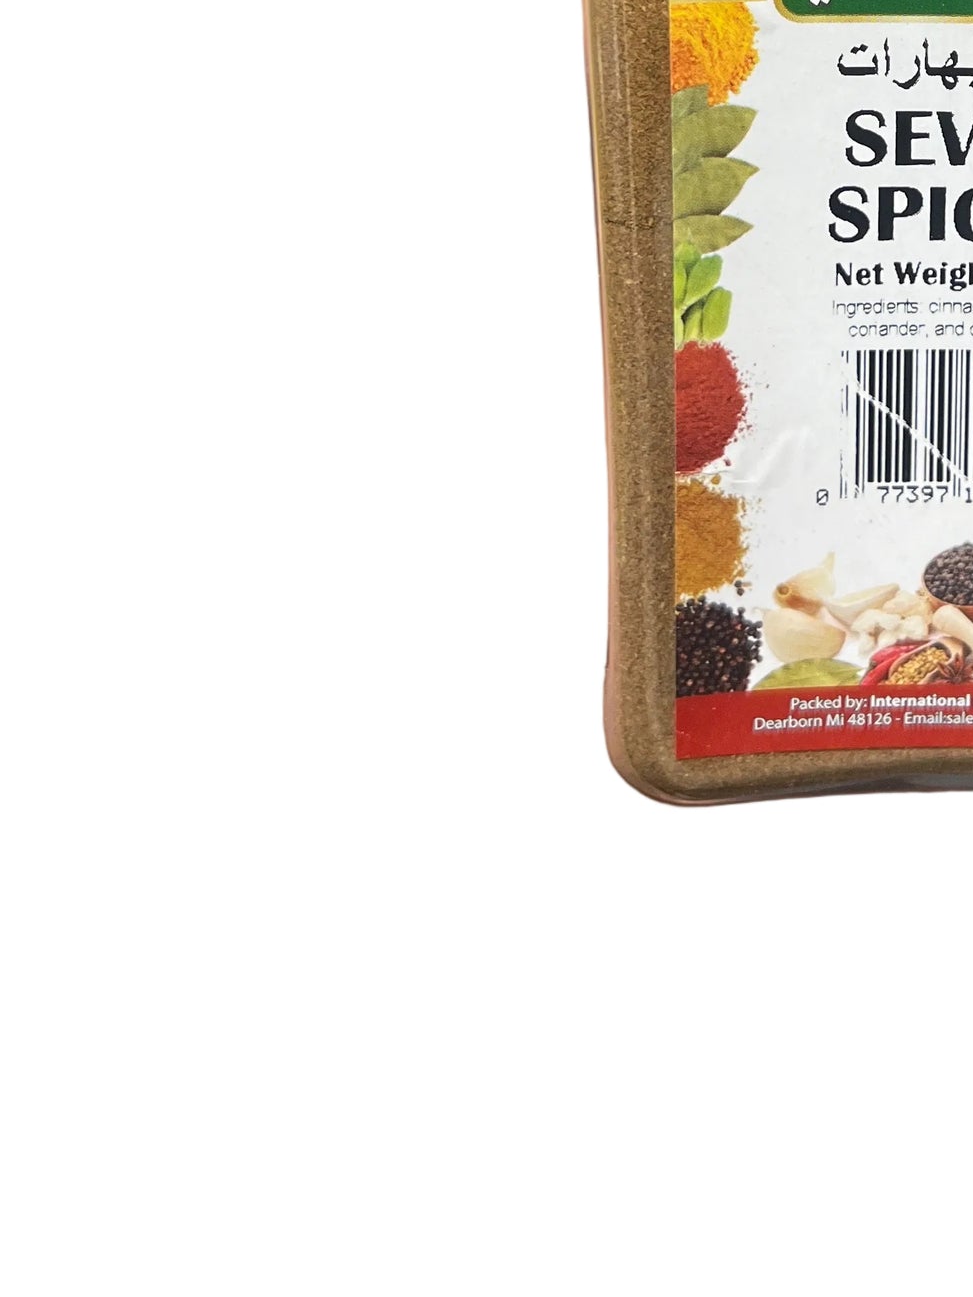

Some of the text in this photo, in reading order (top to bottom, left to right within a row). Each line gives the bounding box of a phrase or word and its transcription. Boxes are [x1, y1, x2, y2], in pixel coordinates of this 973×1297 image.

[835, 263, 883, 286] Net
[849, 323, 928, 338] coriander,
[935, 323, 964, 336] and
[817, 489, 828, 505] 0
[877, 486, 948, 503] 77397
[790, 697, 843, 710] Packed
[846, 695, 868, 709] by:
[870, 694, 970, 707] International
[754, 715, 823, 730] Dearborn
[826, 714, 844, 726] Mi
[848, 712, 892, 725] 48126
